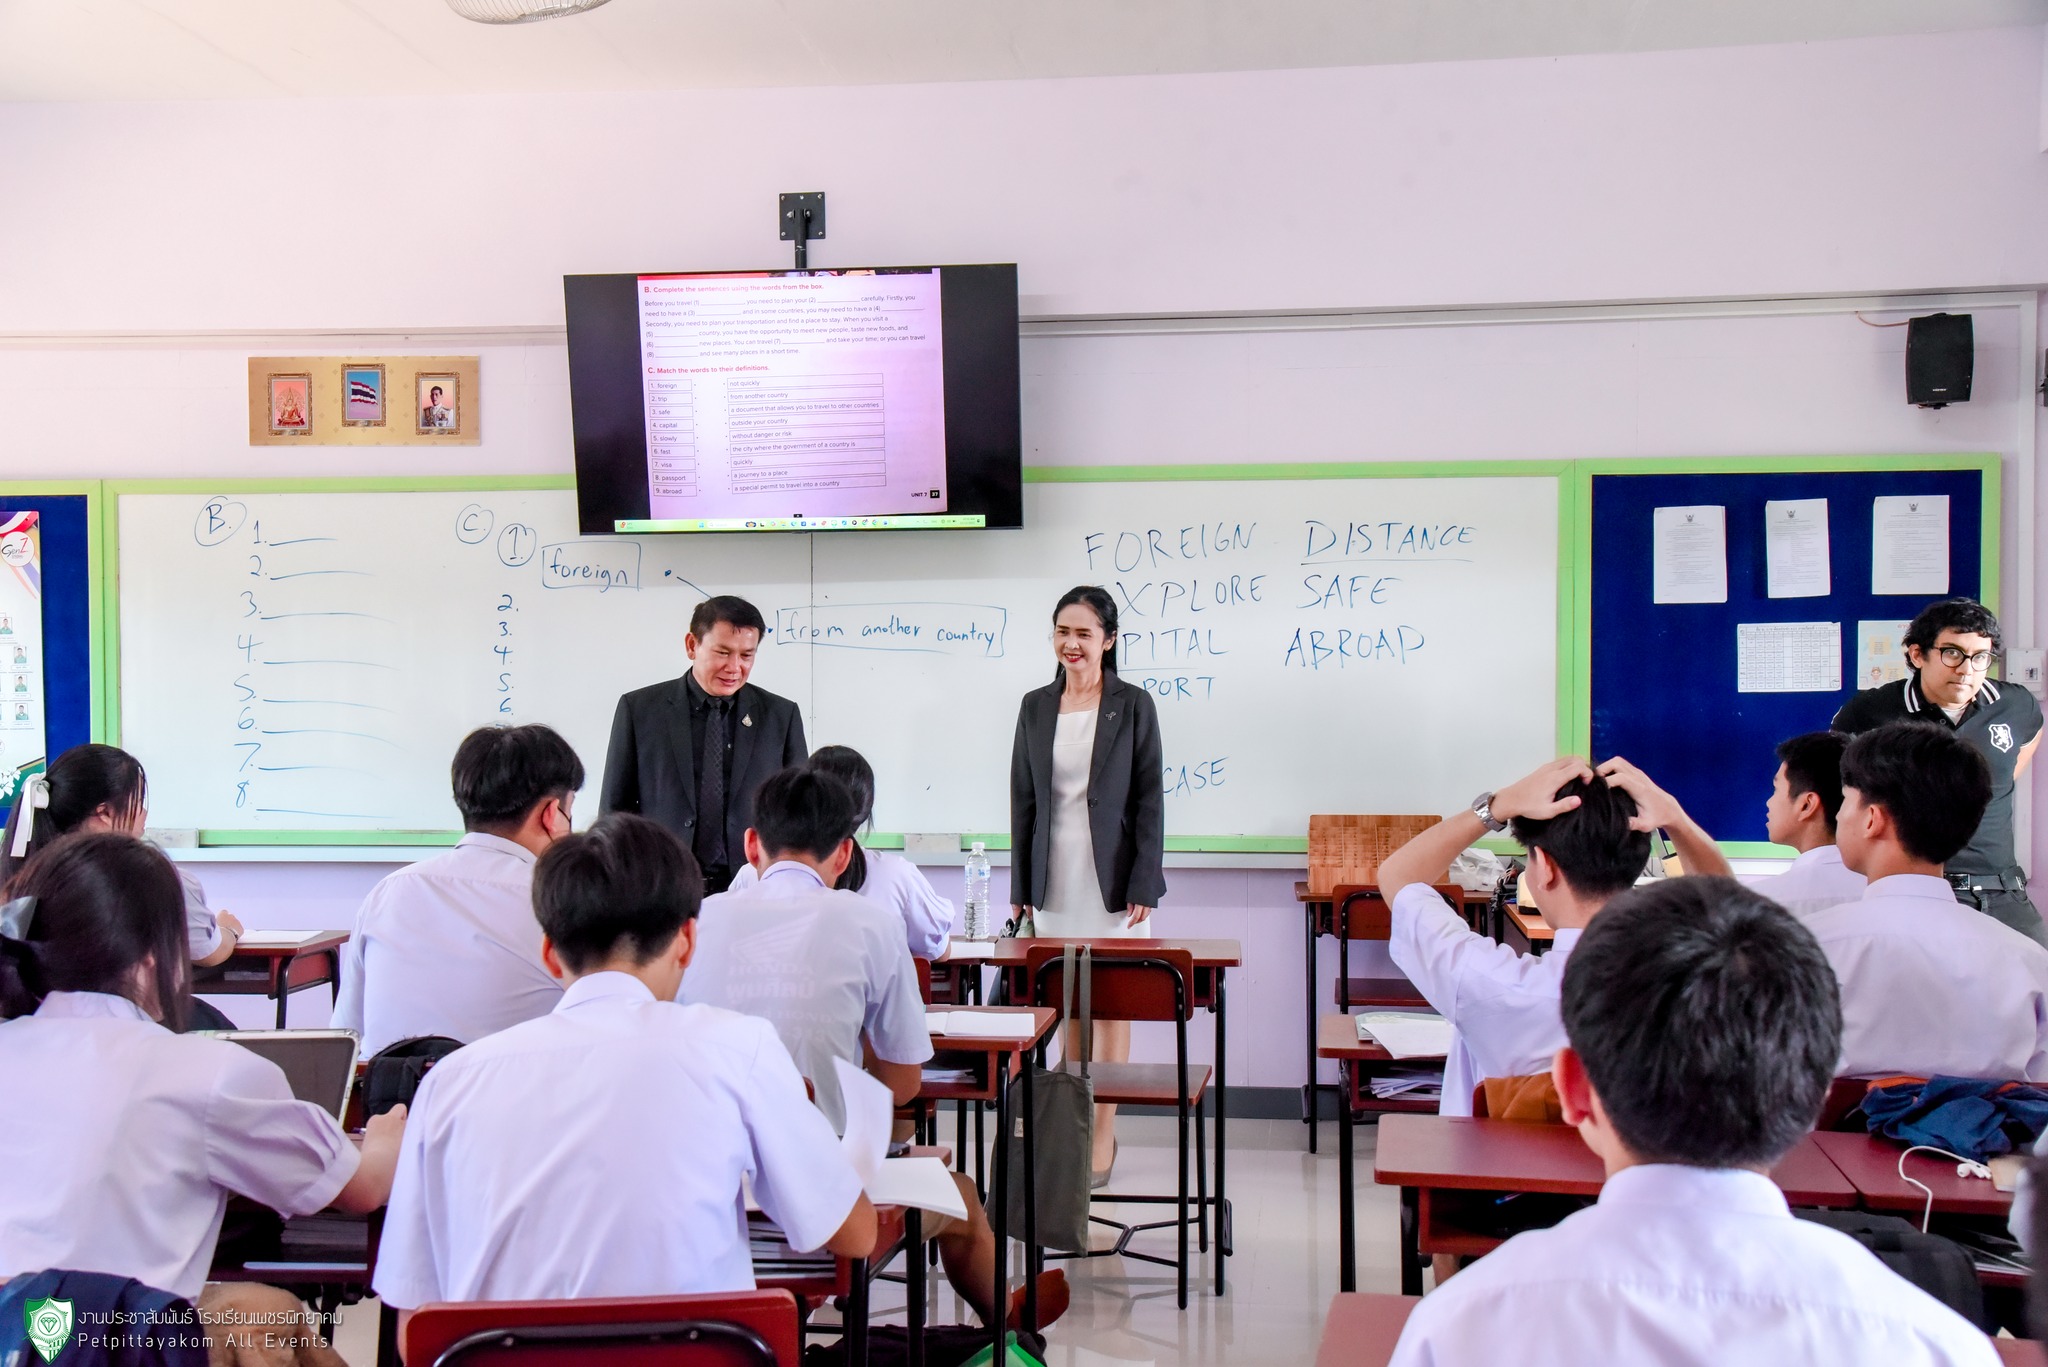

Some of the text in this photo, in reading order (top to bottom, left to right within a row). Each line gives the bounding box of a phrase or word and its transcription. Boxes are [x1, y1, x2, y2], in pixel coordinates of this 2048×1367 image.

[206, 504, 232, 534] B.
[253, 520, 267, 544] 1.
[463, 513, 486, 532] C.
[1085, 520, 1478, 573] FOREIGN DISTANCE
[249, 555, 268, 577] 2.
[550, 548, 628, 593] foreign
[240, 591, 262, 618] 3.
[497, 594, 519, 612] 2.
[1099, 575, 1403, 619] XPLORE SAFE
[498, 621, 513, 636] 3.
[786, 611, 995, 657] from another country
[237, 634, 264, 663] 4.
[494, 645, 513, 665] 4.
[1285, 625, 1426, 670] ABROAD
[234, 673, 257, 702] 5.
[498, 672, 515, 692] 5.
[237, 707, 258, 730] 6.
[500, 698, 514, 716] 6.
[234, 743, 262, 773] 7.
